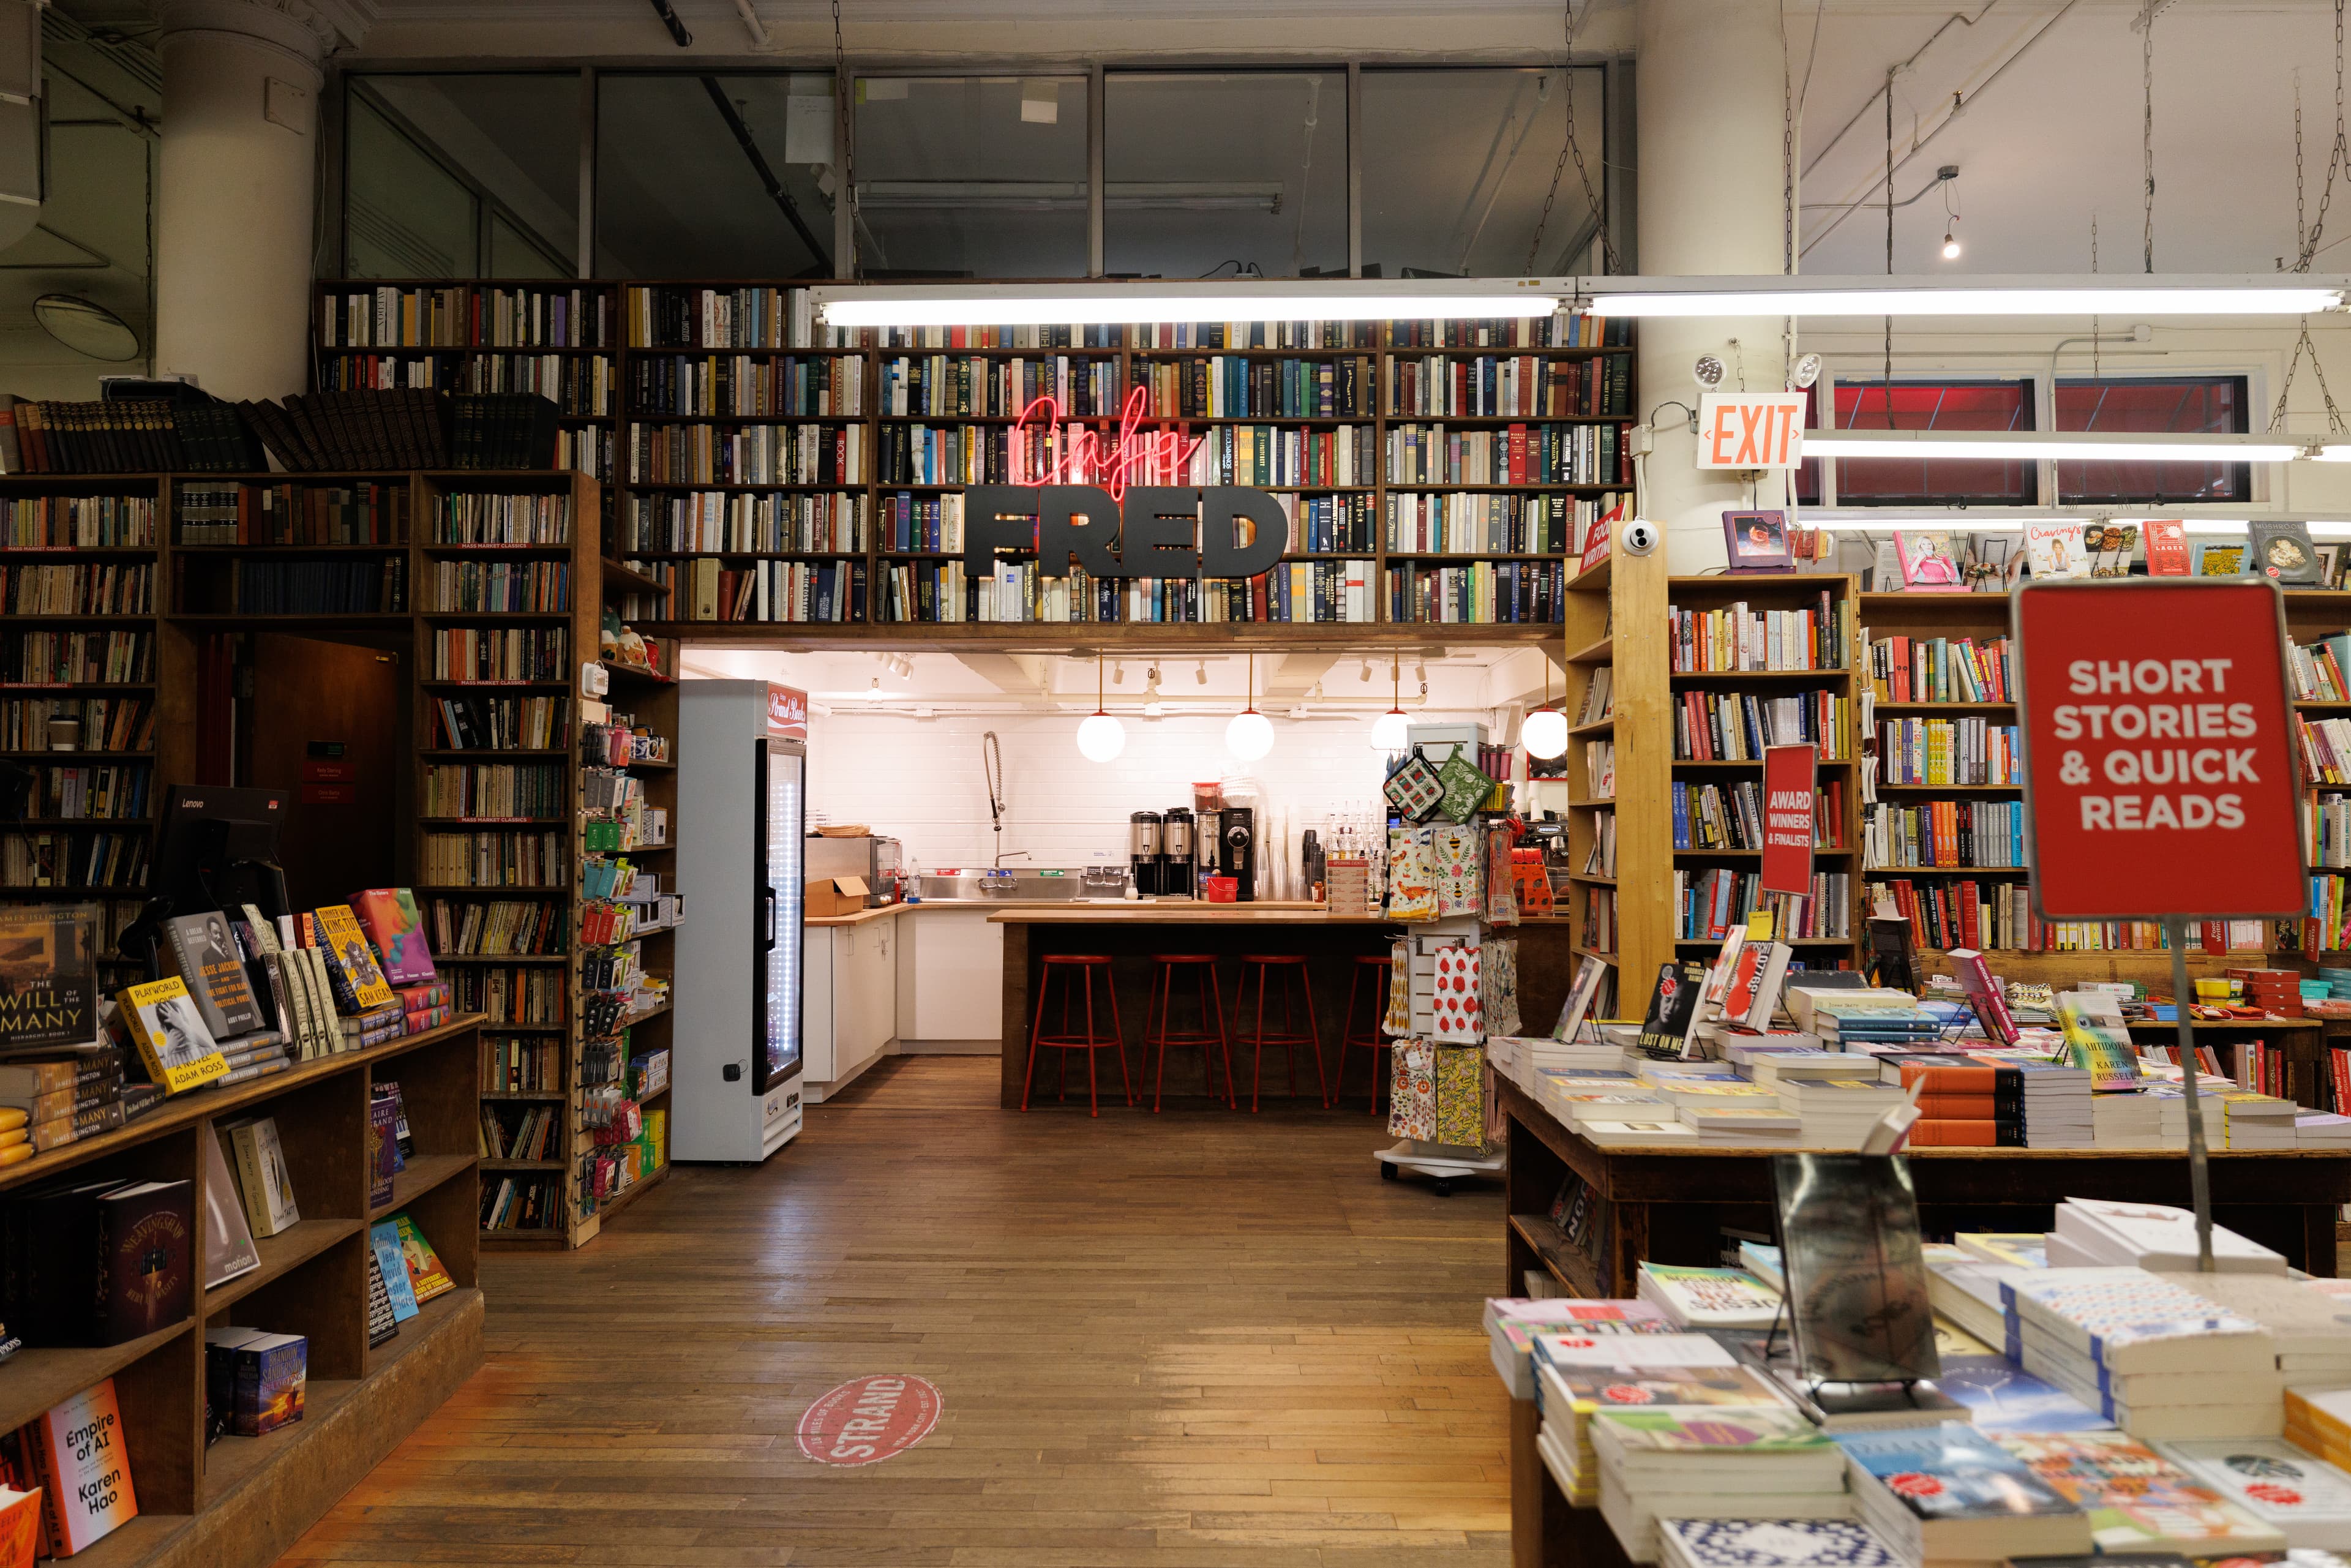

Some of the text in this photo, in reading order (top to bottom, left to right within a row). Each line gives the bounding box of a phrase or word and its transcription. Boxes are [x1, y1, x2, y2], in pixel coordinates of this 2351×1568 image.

[1046, 364, 1055, 399] CAESAR
[1712, 405, 1798, 463] EXIT
[964, 485, 1288, 577] FRED
[1387, 520, 1396, 544] THERE
[2030, 525, 2082, 542] Cravings
[1583, 538, 1611, 569] WRITIN
[1973, 660, 1982, 683] HUANG
[2068, 658, 2232, 694] SHORT
[768, 692, 806, 722] Strand Books
[1709, 715, 1718, 742] RESTAURANT
[2053, 703, 2257, 740] STORIES
[2059, 750, 2091, 785] &
[2104, 748, 2261, 784] QUICK
[182, 798, 204, 808] Lenovo
[1706, 788, 1715, 811] BOURDAIN
[1745, 784, 1757, 819] INGREDIENT
[1769, 791, 1810, 809] AWARD
[1769, 813, 1810, 829] WINNERS
[2080, 793, 2245, 830] READS
[1768, 833, 1809, 847] & FINALISTS
[319, 907, 353, 920] DINNER WITH
[190, 926, 203, 935] DREAM
[324, 917, 360, 935] KING TUT
[187, 935, 207, 945] DEFERRED
[312, 916, 355, 999] DINNER SAM
[199, 960, 241, 977] JESSE JACKSON
[30, 980, 51, 990] THE
[135, 980, 180, 999] PLAYWORLD
[214, 985, 228, 996] FIGHT
[0, 991, 61, 1010] WILL
[214, 994, 250, 1009] POLITICAL POWER
[359, 987, 393, 1005] SAM KEAN
[1976, 959, 2014, 1032] CREATION LAKE RACHEL KUSHNER
[1, 1008, 81, 1033] MANY
[122, 998, 161, 1077] PLAYWORLD ADAM ROSS
[1639, 1032, 1684, 1051] LOST ON ME
[2085, 1042, 2128, 1051] ANTIDOTE
[83, 1056, 110, 1072] MANY
[174, 1061, 224, 1085] ADAM ROSS
[55, 1071, 100, 1089] JAMES ISLINGTON
[2096, 1072, 2136, 1081] RUSSELL
[81, 1083, 108, 1099] MANY
[54, 1098, 99, 1116] JAMES ISLINGTON
[79, 1108, 106, 1127] MANY
[53, 1124, 100, 1144] JAMES ISLINGTON
[378, 1176, 393, 1187] BLOOD
[373, 1232, 397, 1250] Infinite
[224, 1255, 253, 1274] motion
[382, 1250, 395, 1264] Jest
[383, 1264, 402, 1281] David
[269, 1347, 298, 1365] BRANDON
[263, 1357, 304, 1382] SANDERSON
[830, 1379, 906, 1458] STRAND
[66, 1412, 114, 1448] Empire
[77, 1431, 110, 1461] of AI
[32, 1419, 59, 1534] Karen Hao Empire AI
[78, 1469, 121, 1502] Karen
[88, 1490, 118, 1515] Hao
